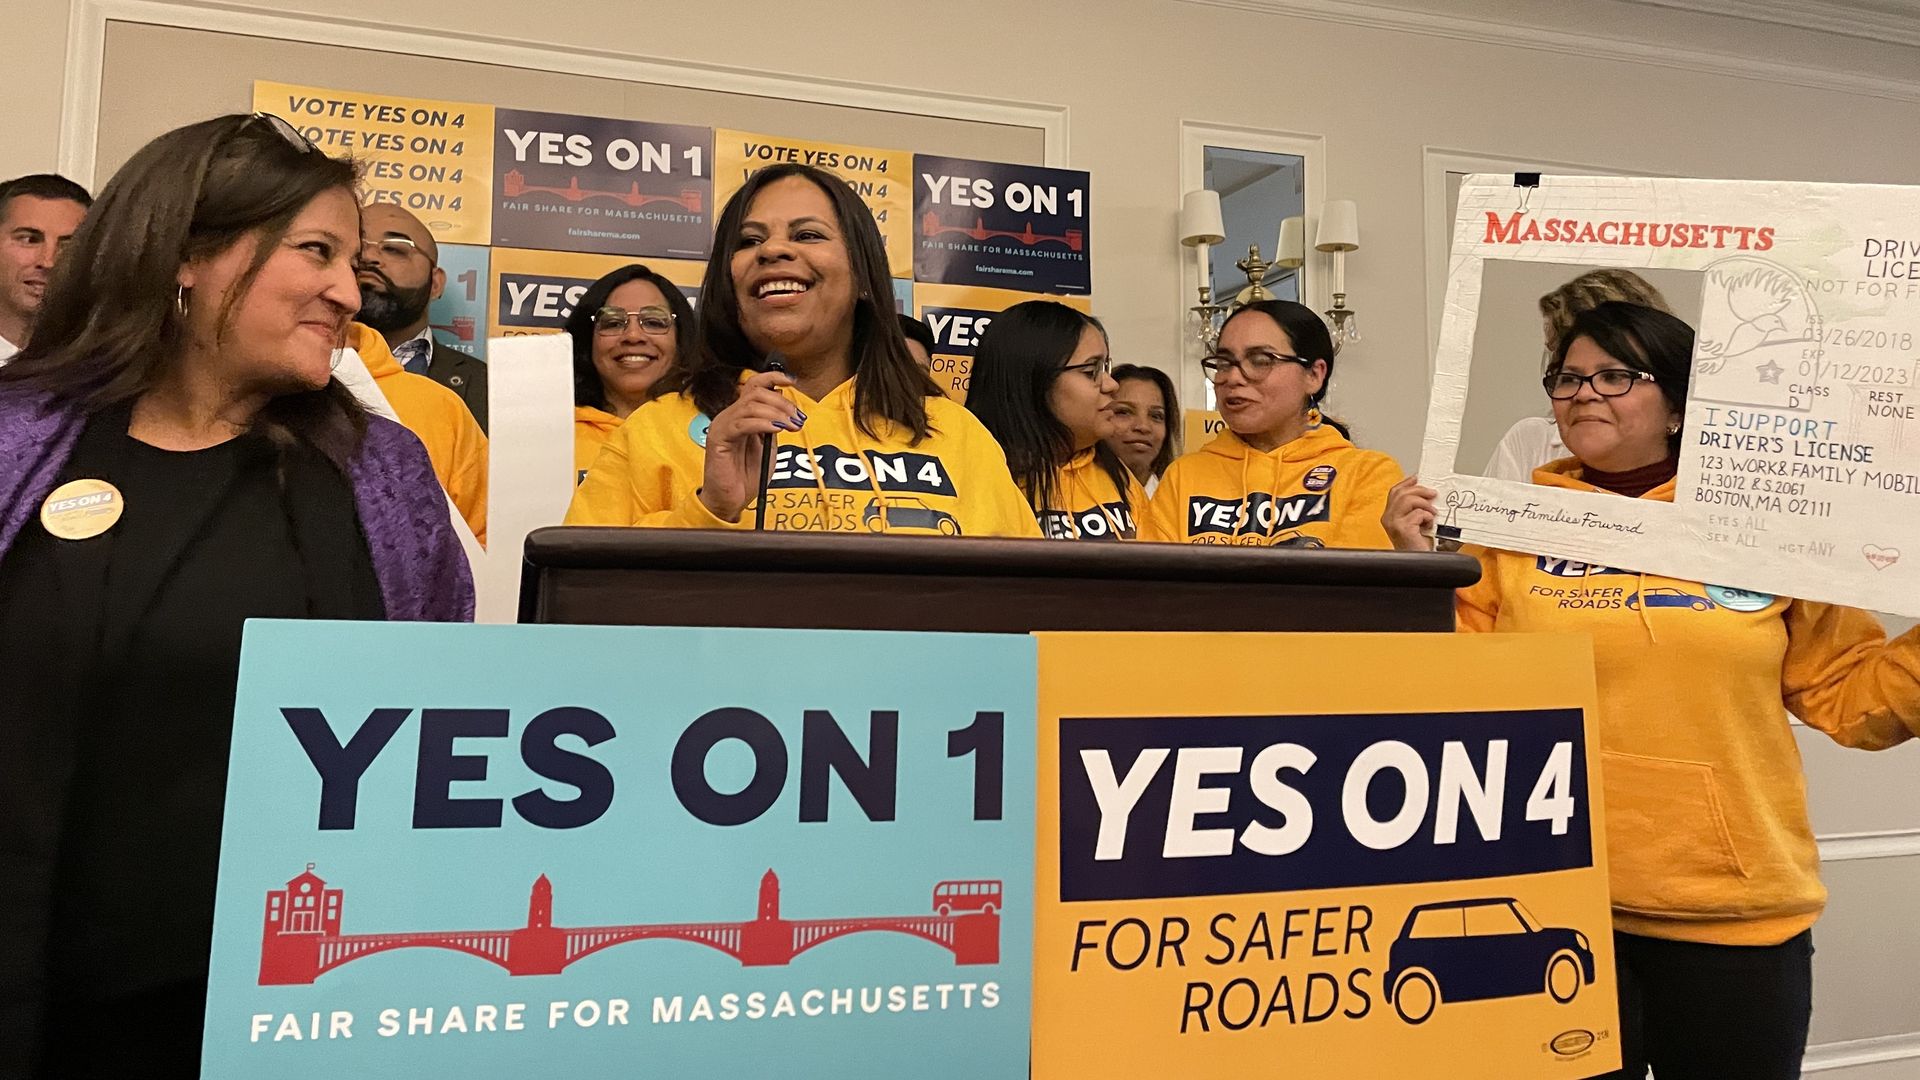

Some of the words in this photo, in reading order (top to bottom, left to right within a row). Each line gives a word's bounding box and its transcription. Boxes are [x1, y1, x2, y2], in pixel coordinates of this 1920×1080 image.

[289, 96, 357, 118] VOTE
[363, 104, 406, 123] YES
[411, 109, 447, 127] ON
[451, 114, 465, 128] 4
[362, 132, 405, 151] YES
[410, 137, 447, 154] ON
[450, 142, 464, 156] 4
[504, 129, 593, 167] YES
[606, 138, 671, 174] ON
[683, 146, 701, 176] 1
[743, 143, 799, 162] VOTE
[803, 150, 839, 168] YES
[843, 155, 873, 171] ON
[876, 160, 888, 173] 4
[409, 165, 446, 182] ON
[449, 169, 463, 183] 4
[876, 184, 888, 198] 4
[922, 173, 994, 209] YES
[1004, 182, 1057, 215] ON
[1067, 189, 1082, 217] 1
[408, 192, 445, 210] ON
[449, 197, 462, 211] 4
[503, 202, 529, 211] FAIR
[534, 204, 573, 214] SHARE
[577, 207, 600, 216] FOR
[605, 209, 702, 224] MASSACHUSETTS
[877, 209, 887, 223] 4
[568, 227, 640, 240] fairsharema.com
[1483, 211, 1775, 251] MASSACHUSETTS
[922, 241, 944, 249] FAIR
[948, 243, 979, 252] SHARE
[983, 245, 1001, 254] FOR
[1005, 248, 1083, 261] MASSACHUSETTS
[457, 270, 477, 301] 1
[1805, 280, 1848, 294] NOT
[1856, 281, 1898, 298] FOR
[1803, 328, 1912, 351] 03/26/2018
[1802, 349, 1825, 360] EXP
[932, 358, 955, 374] OR
[1789, 384, 1830, 397] CLASS
[1869, 391, 1904, 403] REST
[1789, 396, 1799, 408] D
[1867, 405, 1915, 419] NONE
[1205, 419, 1226, 434] VO
[1703, 407, 1721, 427] I
[1725, 410, 1838, 440] SUPPORT
[1699, 431, 1784, 453] DRIVER'S
[1794, 440, 1874, 463] LICENSE
[771, 451, 825, 480] ES
[835, 456, 907, 483] ON
[917, 461, 943, 487] 4
[1700, 455, 1723, 470] 123
[1700, 473, 1745, 490] H.3012
[50, 499, 78, 512] YES
[79, 494, 101, 505] ON
[103, 493, 112, 501] 4
[1788, 499, 1831, 517] 02111
[776, 513, 856, 530] ROADS
[1081, 508, 1126, 537] ON
[1192, 502, 1250, 528] YES
[1256, 499, 1306, 529] ON
[1520, 503, 1582, 524] Families
[1581, 512, 1645, 535] Forward
[1746, 516, 1769, 531] ALL
[1707, 532, 1729, 543] SEX
[1736, 534, 1761, 548] ALL
[1808, 541, 1836, 557] ANY
[1529, 585, 1564, 597] FOR
[1567, 588, 1624, 598] SAFER
[1558, 599, 1622, 609] ROADS
[280, 706, 617, 830] YES
[670, 706, 899, 826] ON
[946, 711, 1005, 820] 1
[1080, 742, 1318, 861] YES
[1342, 739, 1508, 850] ON
[1525, 741, 1574, 836] 4
[1070, 916, 1190, 972] FOR
[1204, 905, 1373, 966] SAFER
[1180, 967, 1373, 1034] ROADS
[250, 1011, 354, 1042] FAIR
[378, 1002, 525, 1038] SHARE
[547, 998, 630, 1029] FOR
[652, 982, 1001, 1024] MASSACHUSETTS
